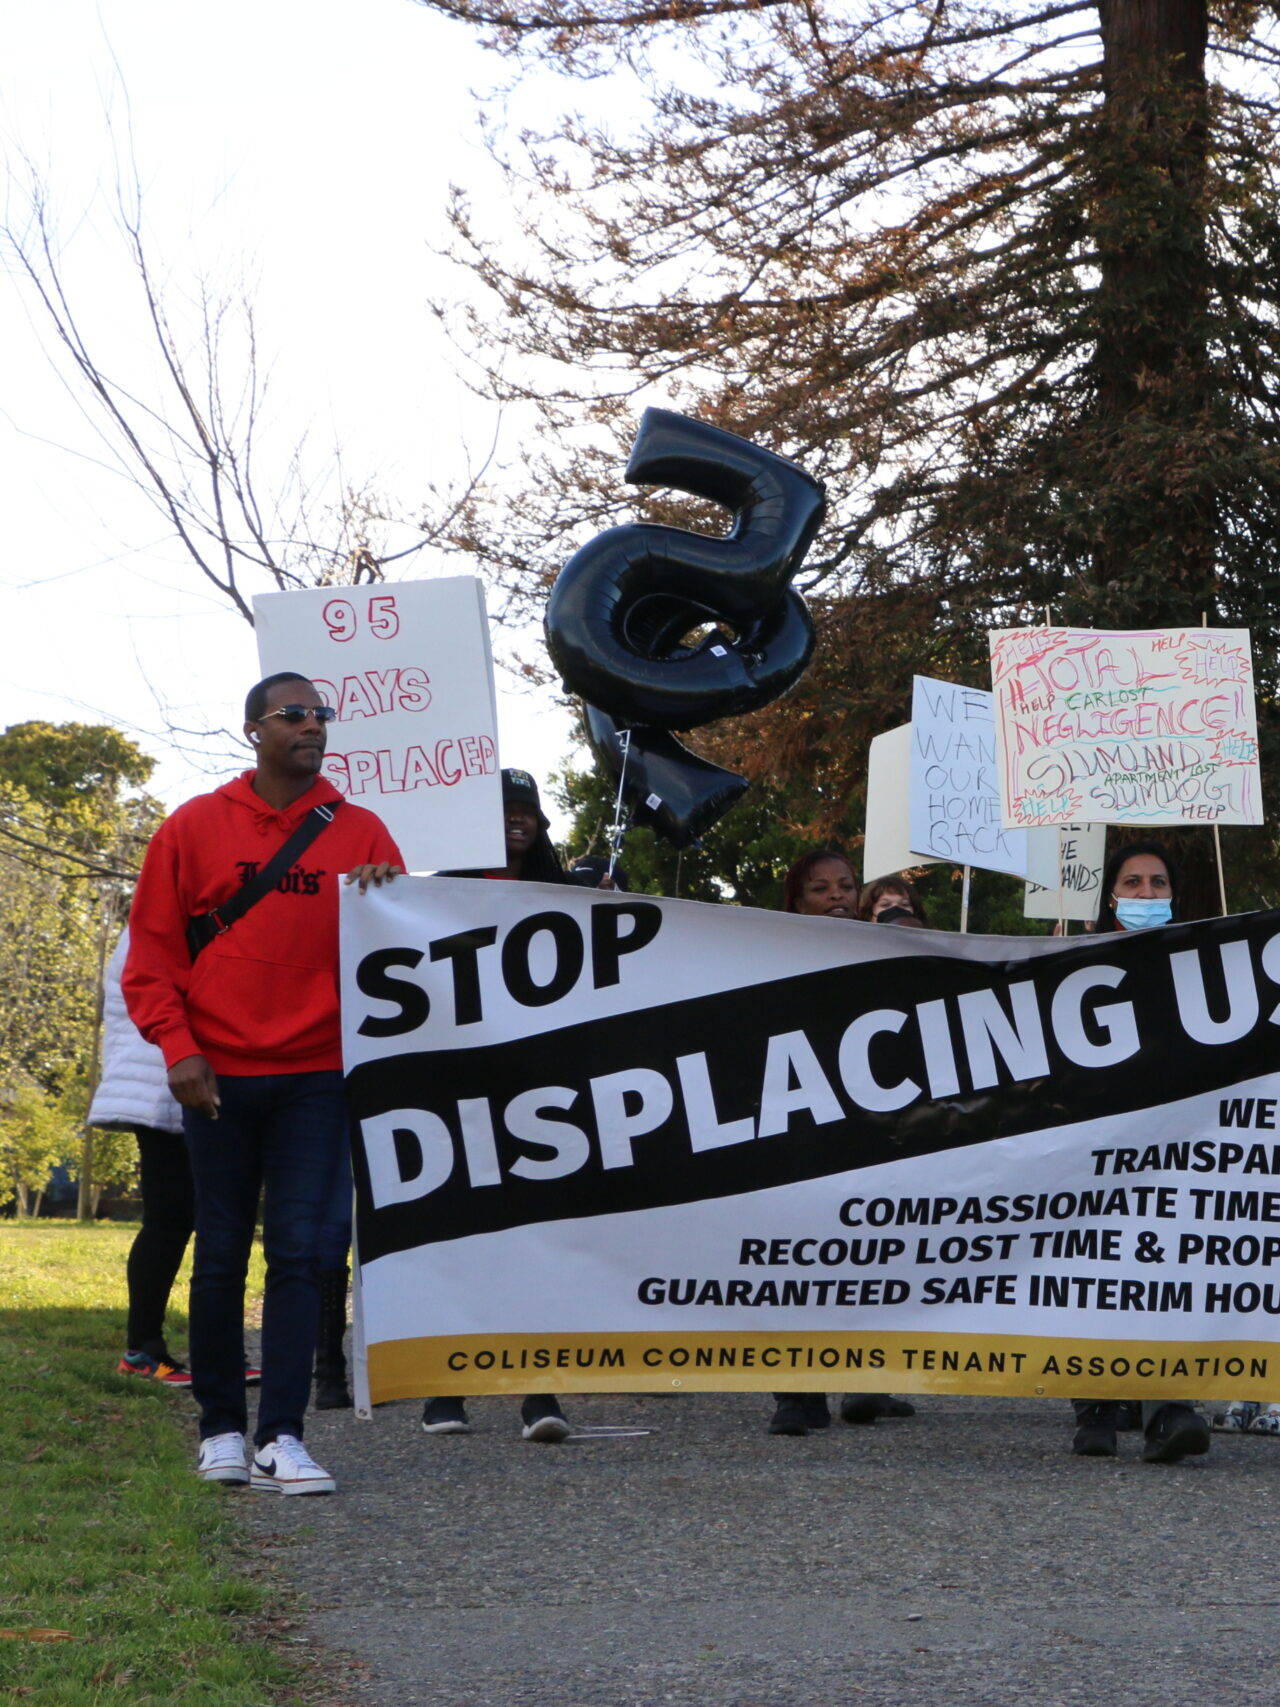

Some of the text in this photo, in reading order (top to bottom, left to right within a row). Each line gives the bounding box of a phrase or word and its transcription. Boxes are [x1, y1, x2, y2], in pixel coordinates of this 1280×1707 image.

[1152, 633, 1185, 652] HELP
[1196, 651, 1239, 680] HELP
[916, 727, 996, 764] WAN
[322, 735, 498, 796] SPLACED
[925, 765, 1000, 795] OUR
[1021, 795, 1069, 817] HELP
[1182, 803, 1226, 820] HELP
[927, 820, 1012, 858] BACK
[356, 902, 663, 1038] STOP
[360, 965, 1141, 1210] DISPLACING
[1218, 1098, 1278, 1130] WE
[839, 1186, 1178, 1228] COMPASSIONATE
[738, 1238, 906, 1266] RECOUP
[915, 1234, 1020, 1264] LOST
[1030, 1229, 1123, 1261] TIME
[1134, 1230, 1166, 1264] &
[637, 1276, 911, 1306] GUARANTEED
[920, 1275, 1018, 1306] SAFE
[1029, 1275, 1193, 1312] INTERIM
[447, 1347, 1268, 1378] COLISEUM CONNECTIONS TENANT ASSOCIATION
